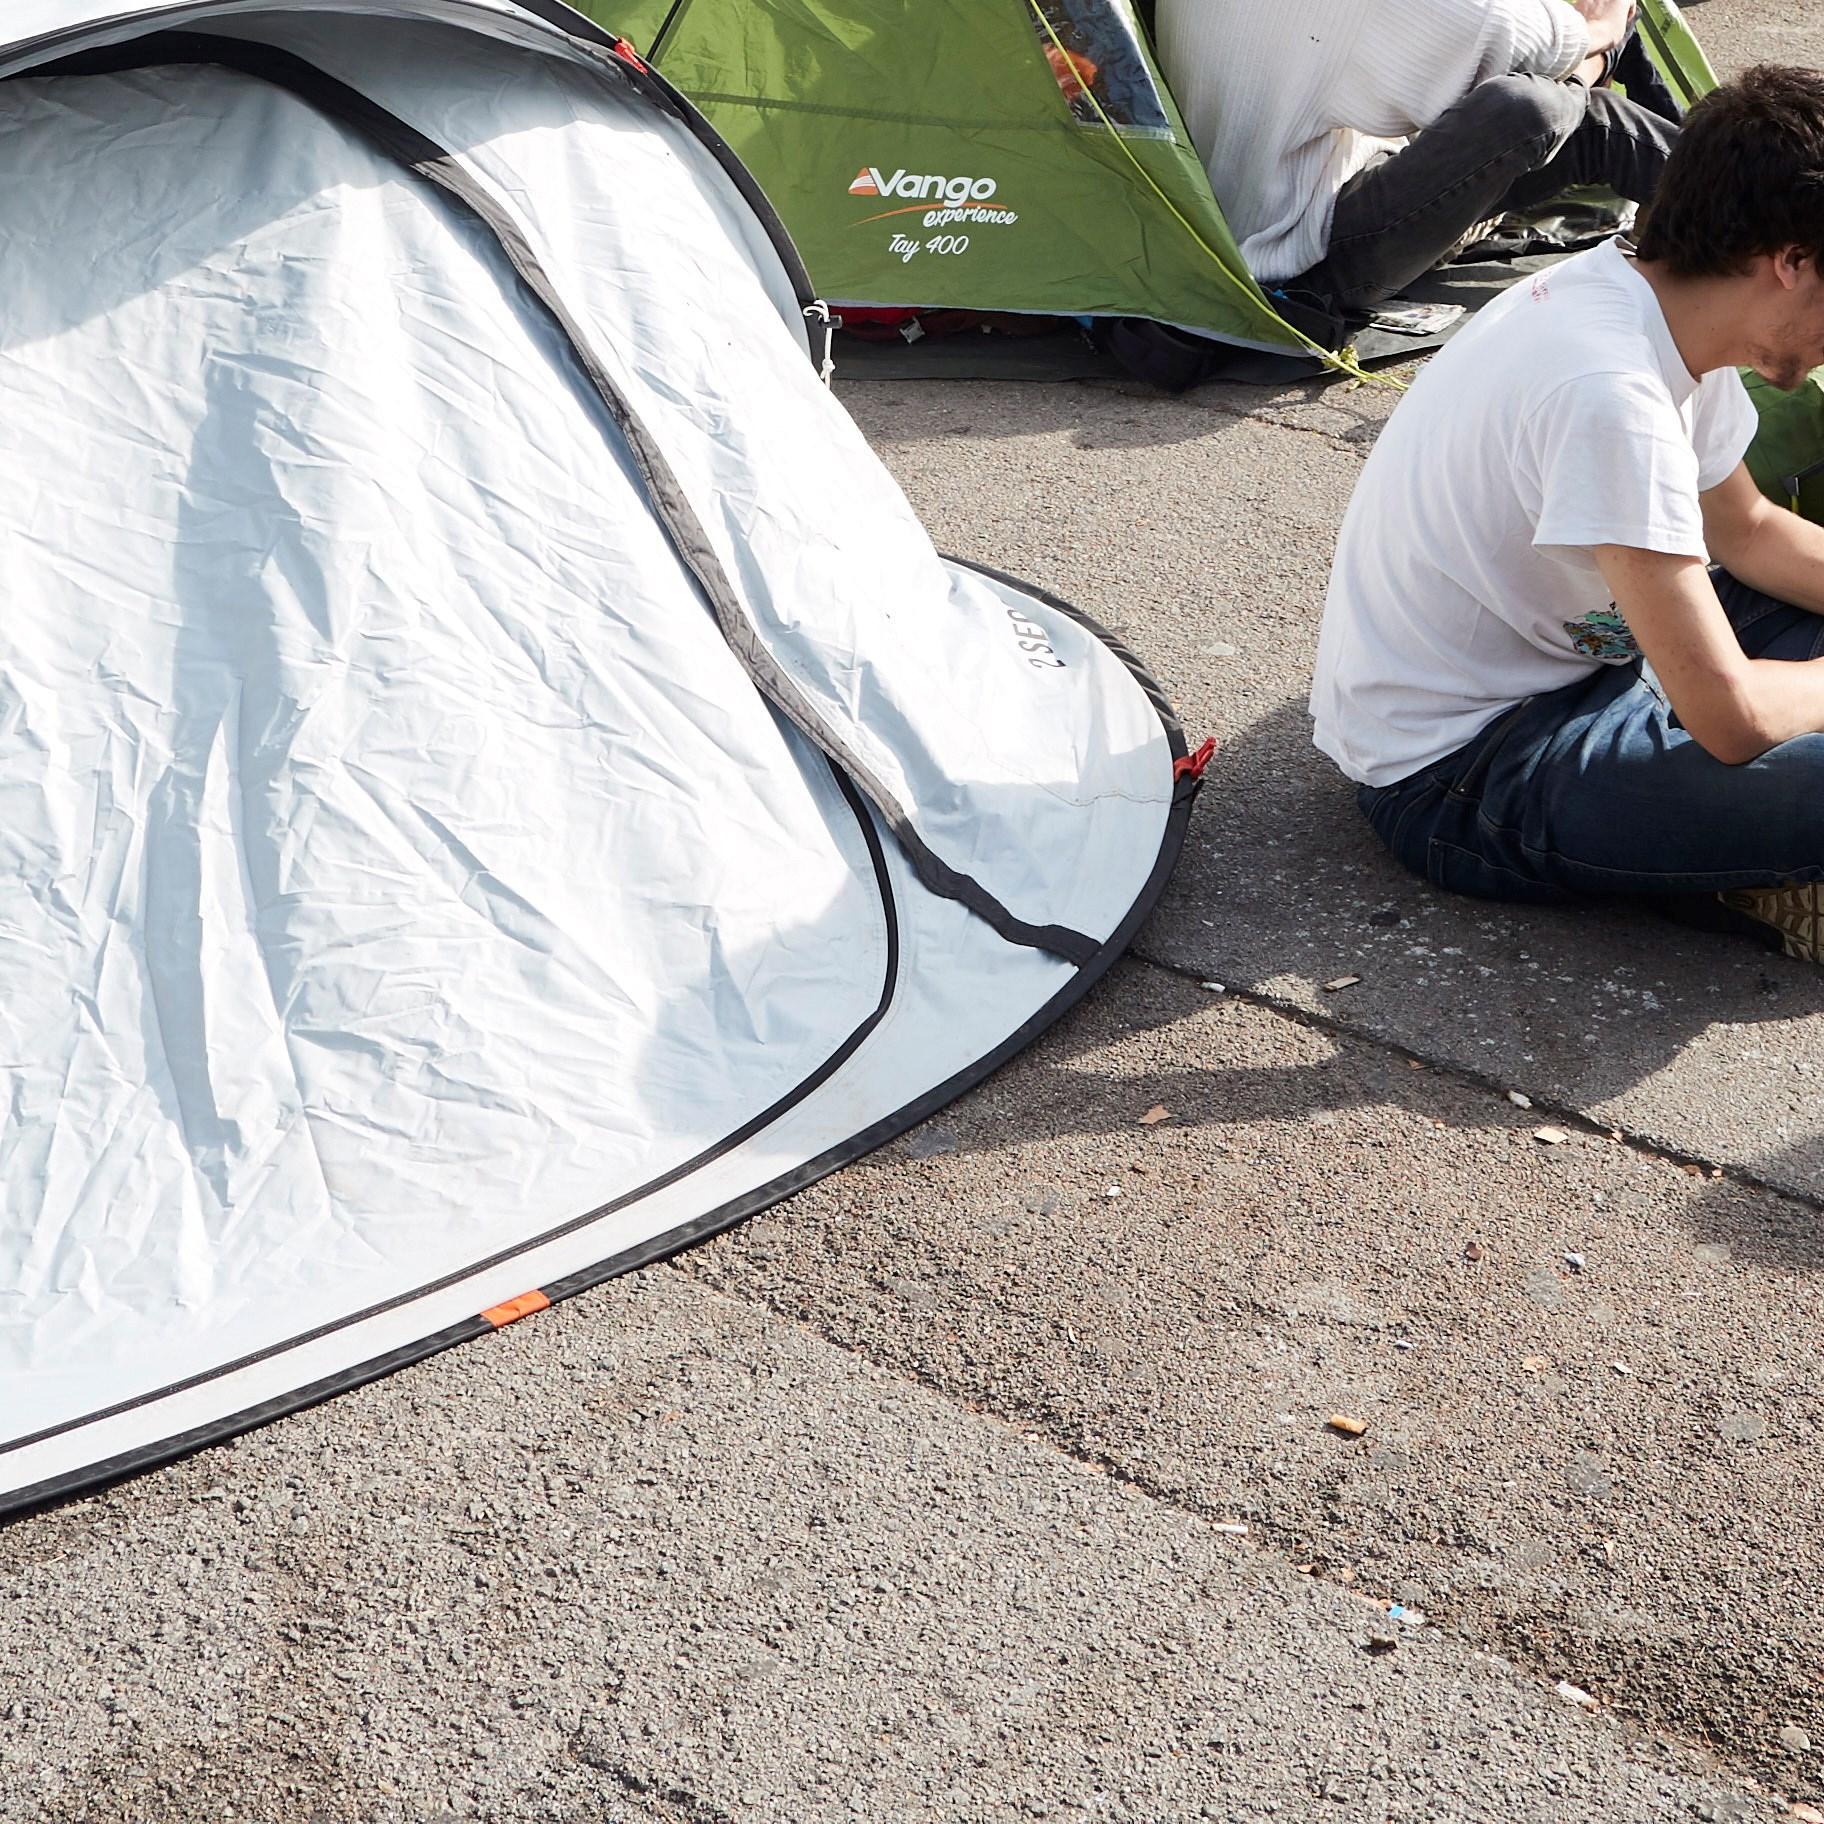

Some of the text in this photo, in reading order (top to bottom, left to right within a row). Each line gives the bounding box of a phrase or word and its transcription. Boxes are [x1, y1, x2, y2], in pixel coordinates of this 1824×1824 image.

[868, 167, 997, 208] Vango
[923, 206, 1018, 227] experience
[888, 233, 970, 263] Tay 400
